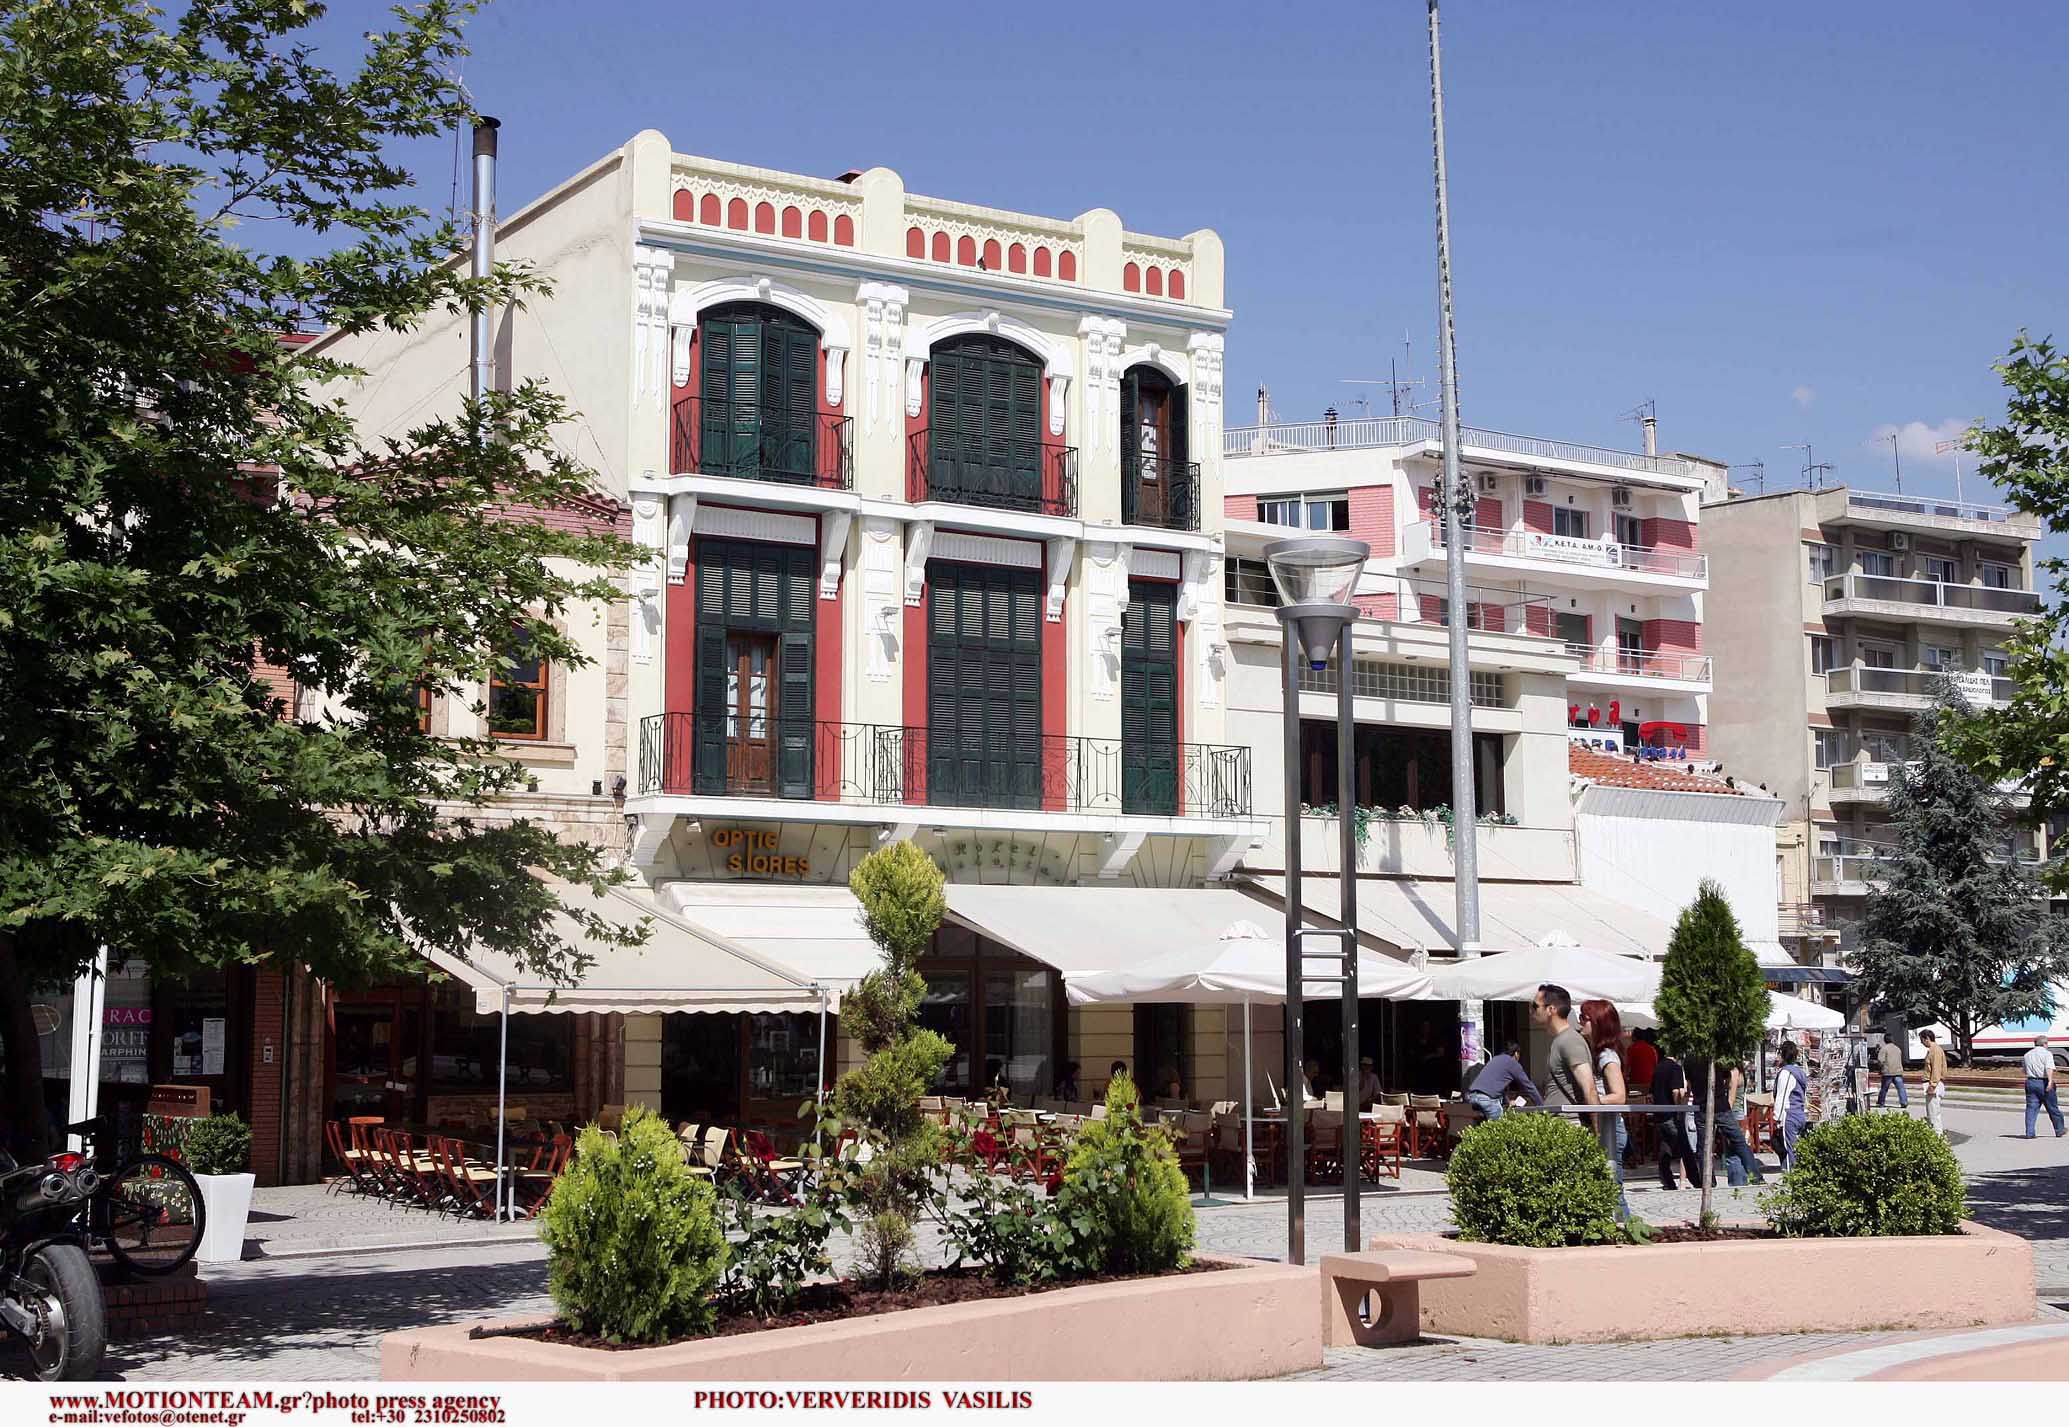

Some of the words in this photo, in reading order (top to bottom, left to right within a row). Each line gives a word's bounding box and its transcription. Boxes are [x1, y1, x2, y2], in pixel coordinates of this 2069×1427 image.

[713, 830, 778, 849] OPTIC
[728, 853, 810, 874] STORES
[110, 1009, 152, 1023] RAC
[101, 1048, 147, 1056] ARPHIN
